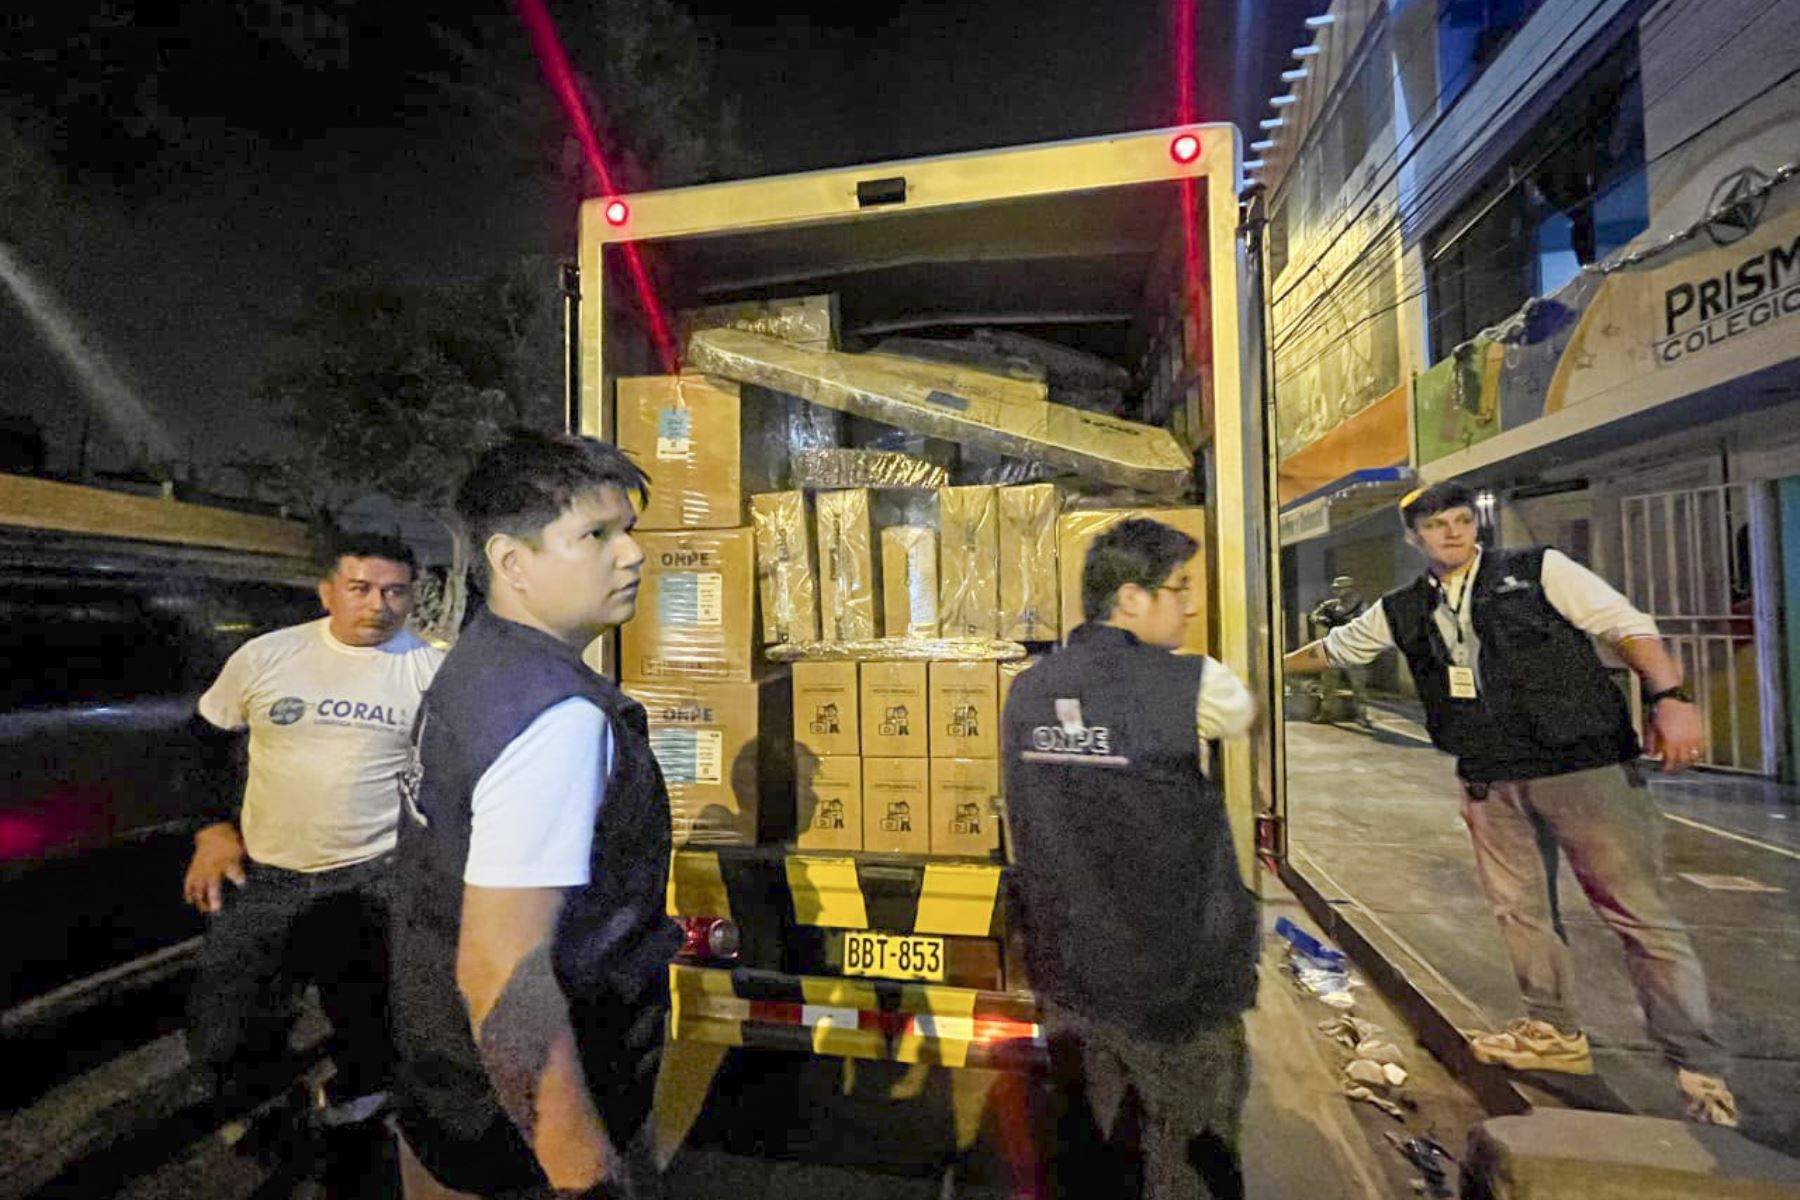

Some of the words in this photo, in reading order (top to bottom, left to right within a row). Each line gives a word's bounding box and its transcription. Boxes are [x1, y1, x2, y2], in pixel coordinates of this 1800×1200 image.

[1663, 287, 1800, 362] COLEGIO
[317, 699, 397, 725] CORAL
[848, 937, 940, 973] BBT-853
